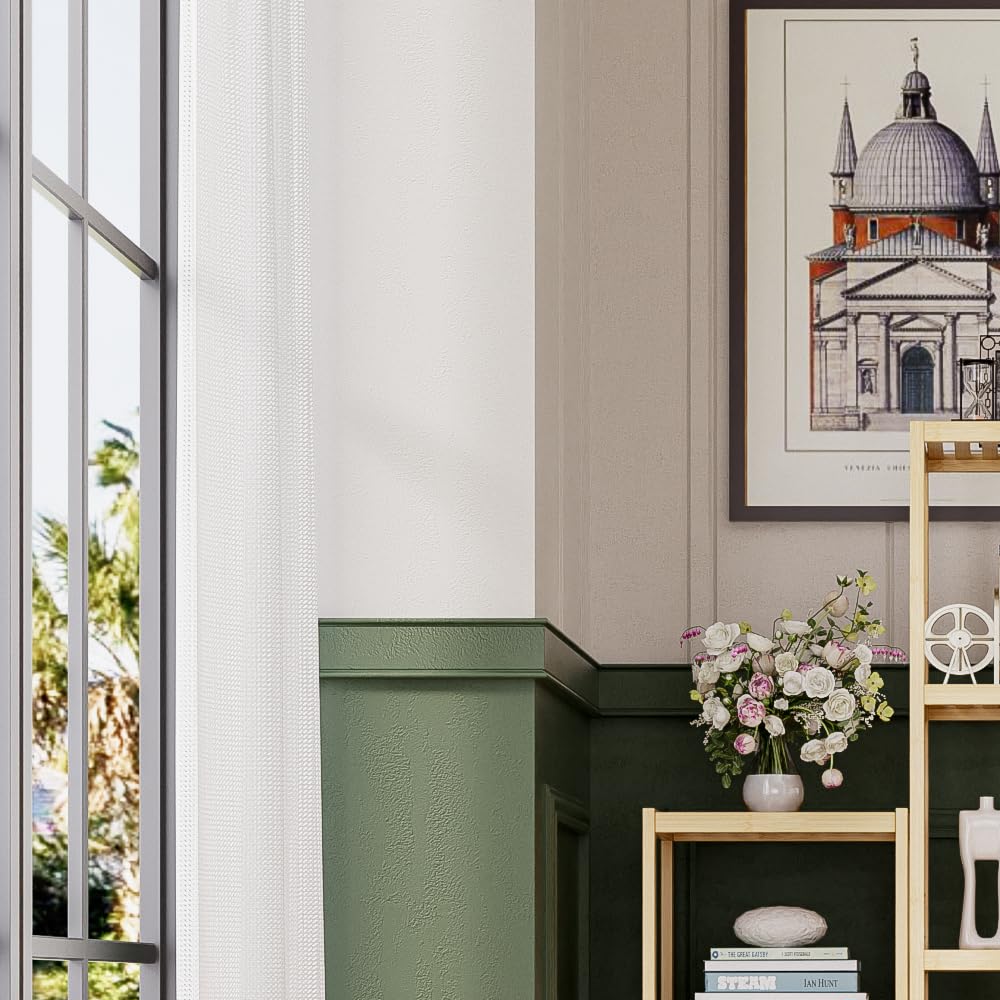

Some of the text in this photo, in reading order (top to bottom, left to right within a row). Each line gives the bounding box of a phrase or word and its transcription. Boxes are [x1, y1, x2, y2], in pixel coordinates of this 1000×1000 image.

[717, 975, 777, 990] STEAM
[803, 978, 839, 988] IAN HUNT
